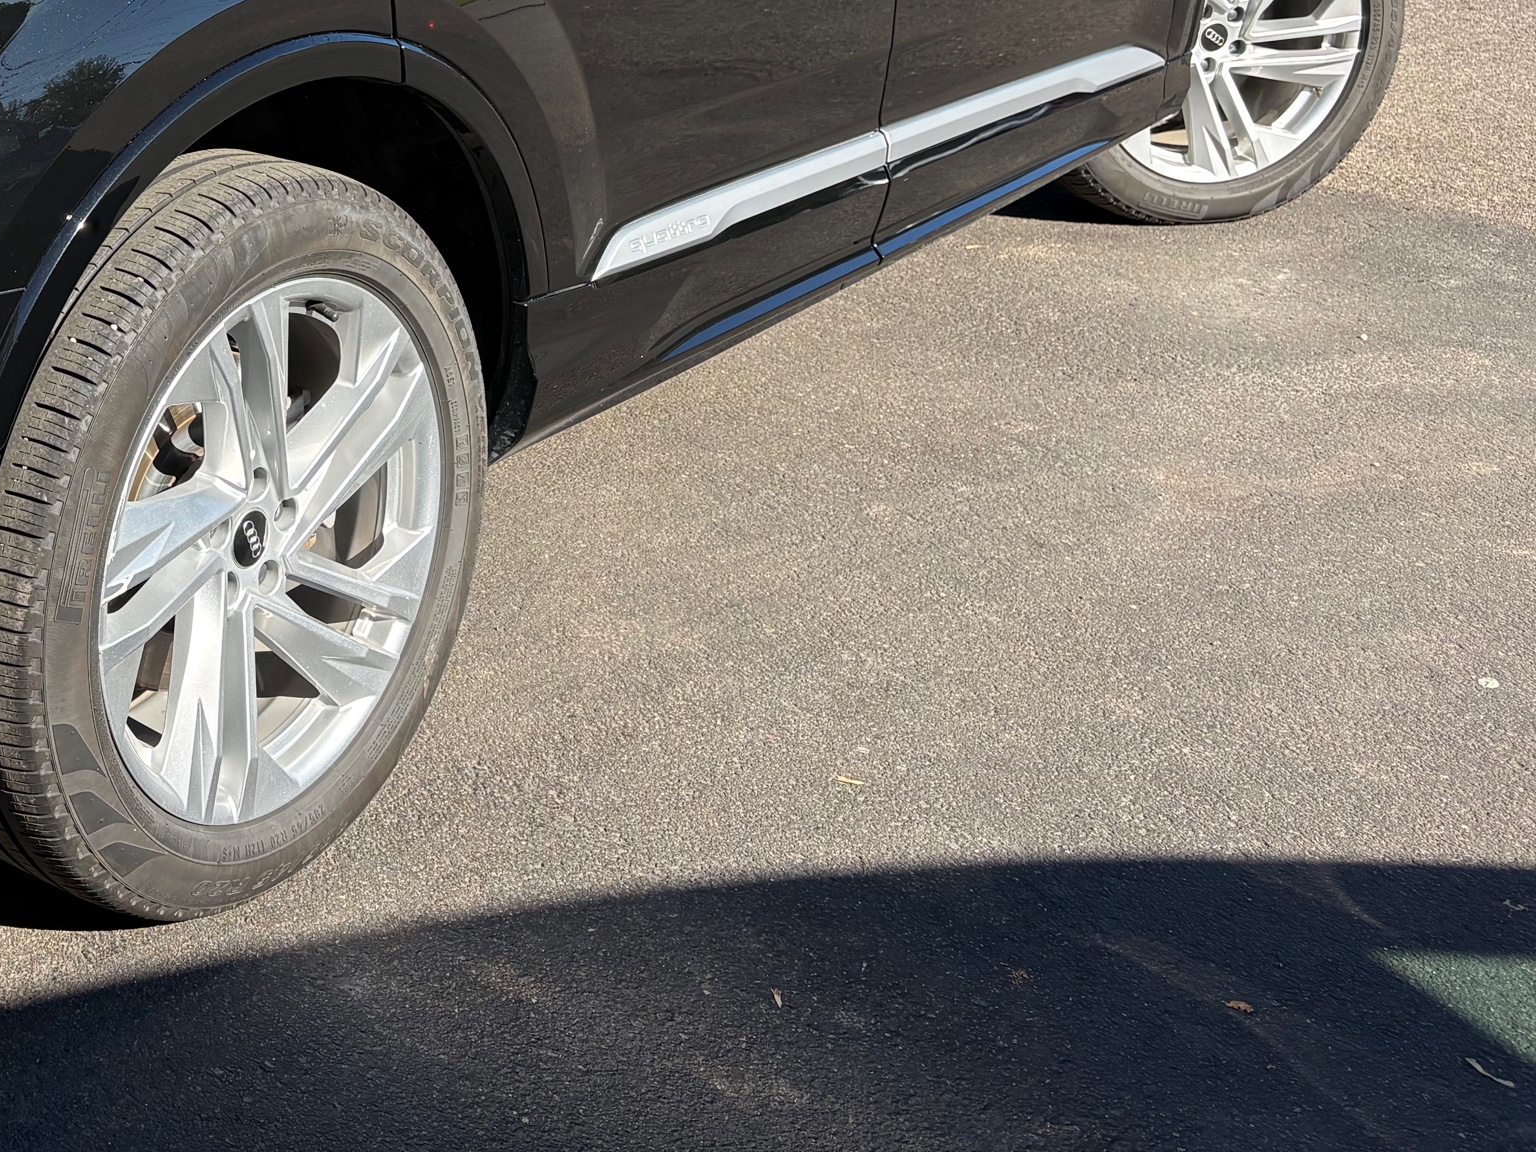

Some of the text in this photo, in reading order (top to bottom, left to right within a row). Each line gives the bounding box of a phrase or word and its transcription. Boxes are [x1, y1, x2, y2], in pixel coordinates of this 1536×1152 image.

[628, 213, 712, 255] quattro
[359, 218, 482, 382] SCORPION
[53, 467, 112, 625] PIRELLI
[269, 831, 289, 846] R20
